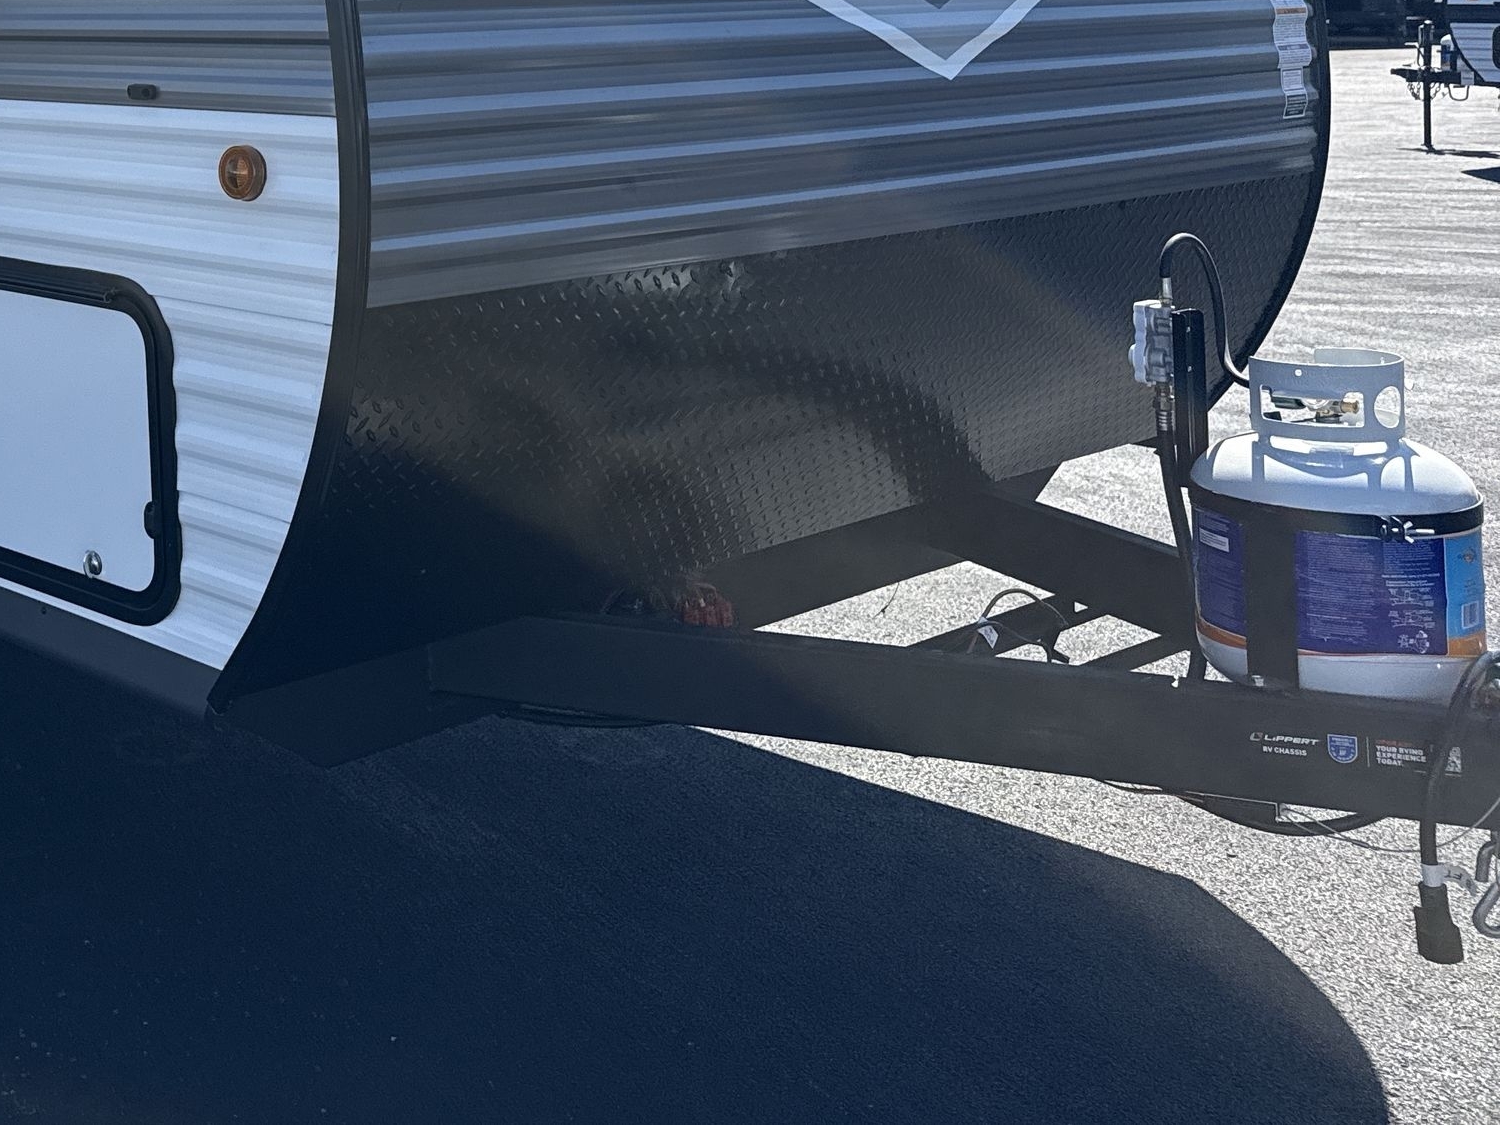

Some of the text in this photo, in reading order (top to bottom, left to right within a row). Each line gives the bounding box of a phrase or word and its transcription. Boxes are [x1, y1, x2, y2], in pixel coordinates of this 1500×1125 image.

[1263, 734, 1320, 746] LIPPERT
[1262, 745, 1308, 757] RV CHASSIS
[1375, 745, 1398, 753] YOUR
[1375, 751, 1427, 763] EXPERIENCE
